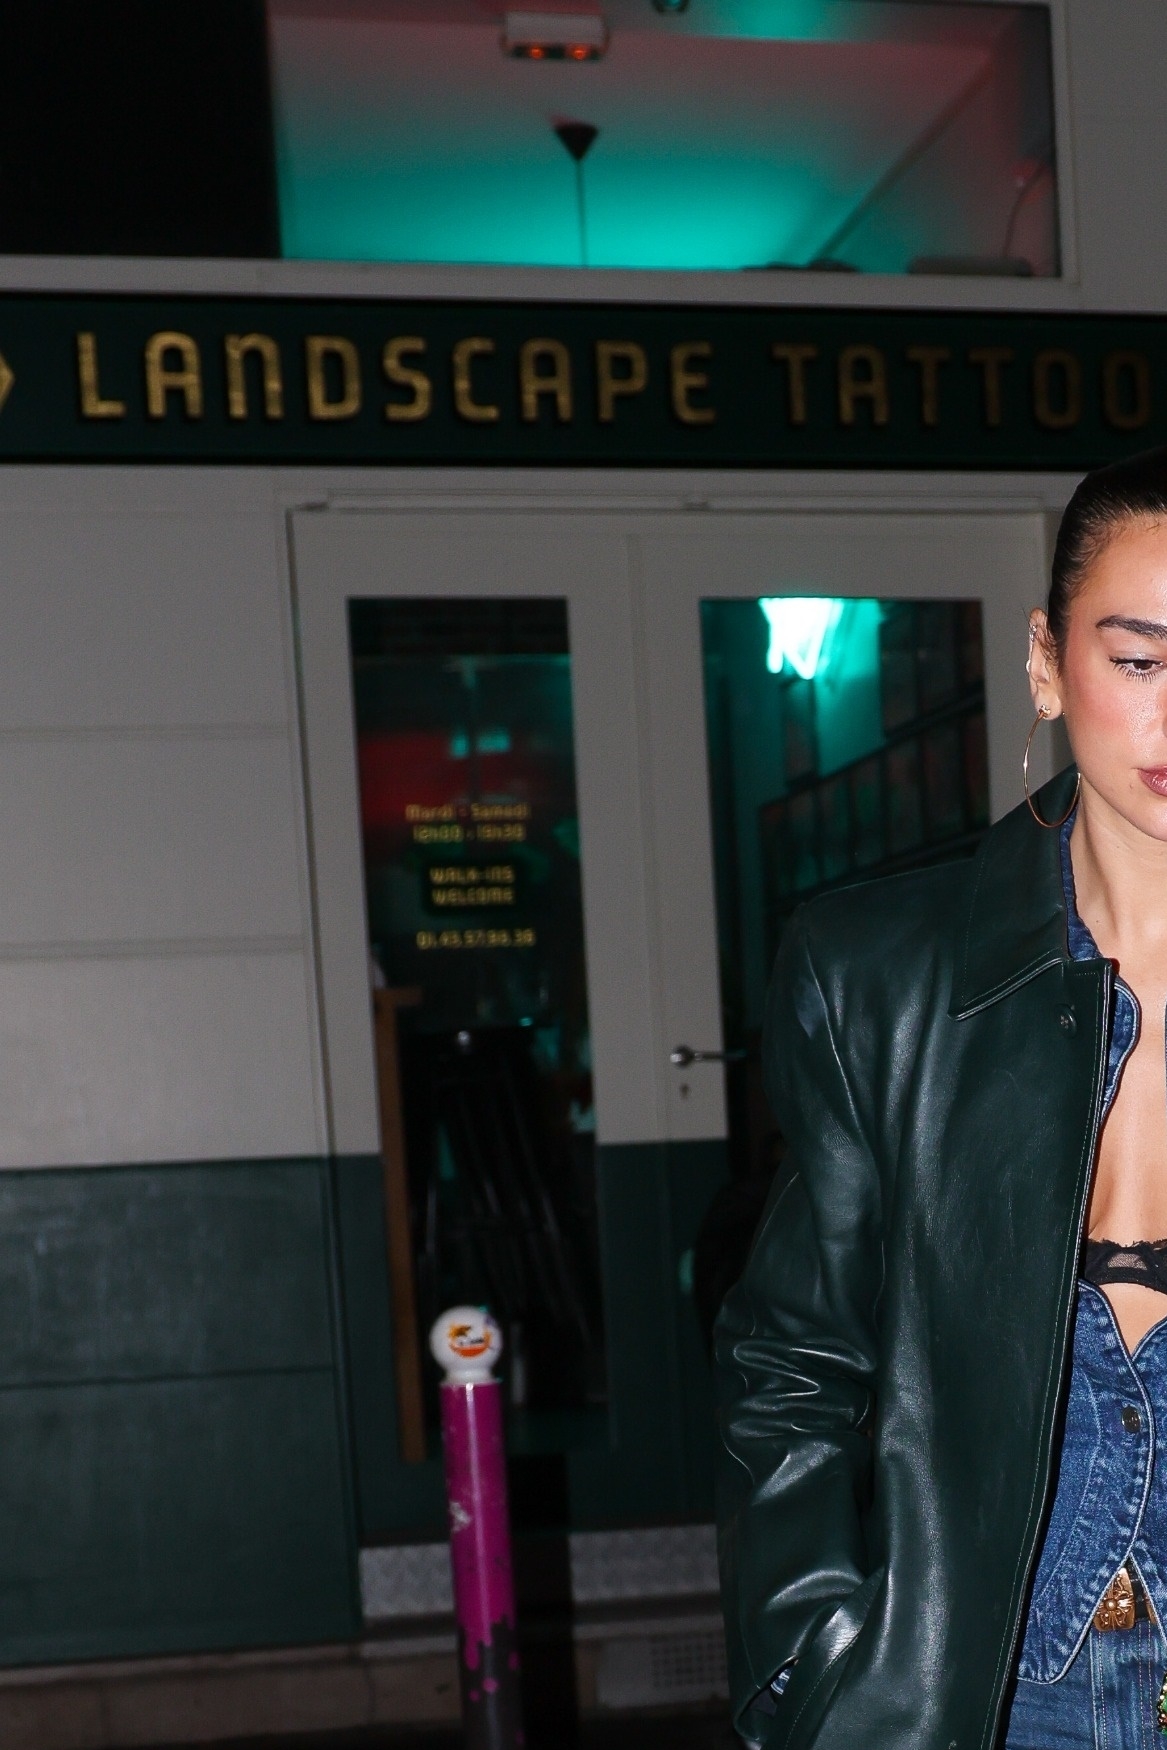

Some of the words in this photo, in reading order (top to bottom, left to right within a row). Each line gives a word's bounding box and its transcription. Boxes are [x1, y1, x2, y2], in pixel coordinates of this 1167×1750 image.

[75, 330, 718, 424] LANDSCAPE
[771, 342, 1153, 430] TATTOO
[432, 887, 515, 905] WELCOME
